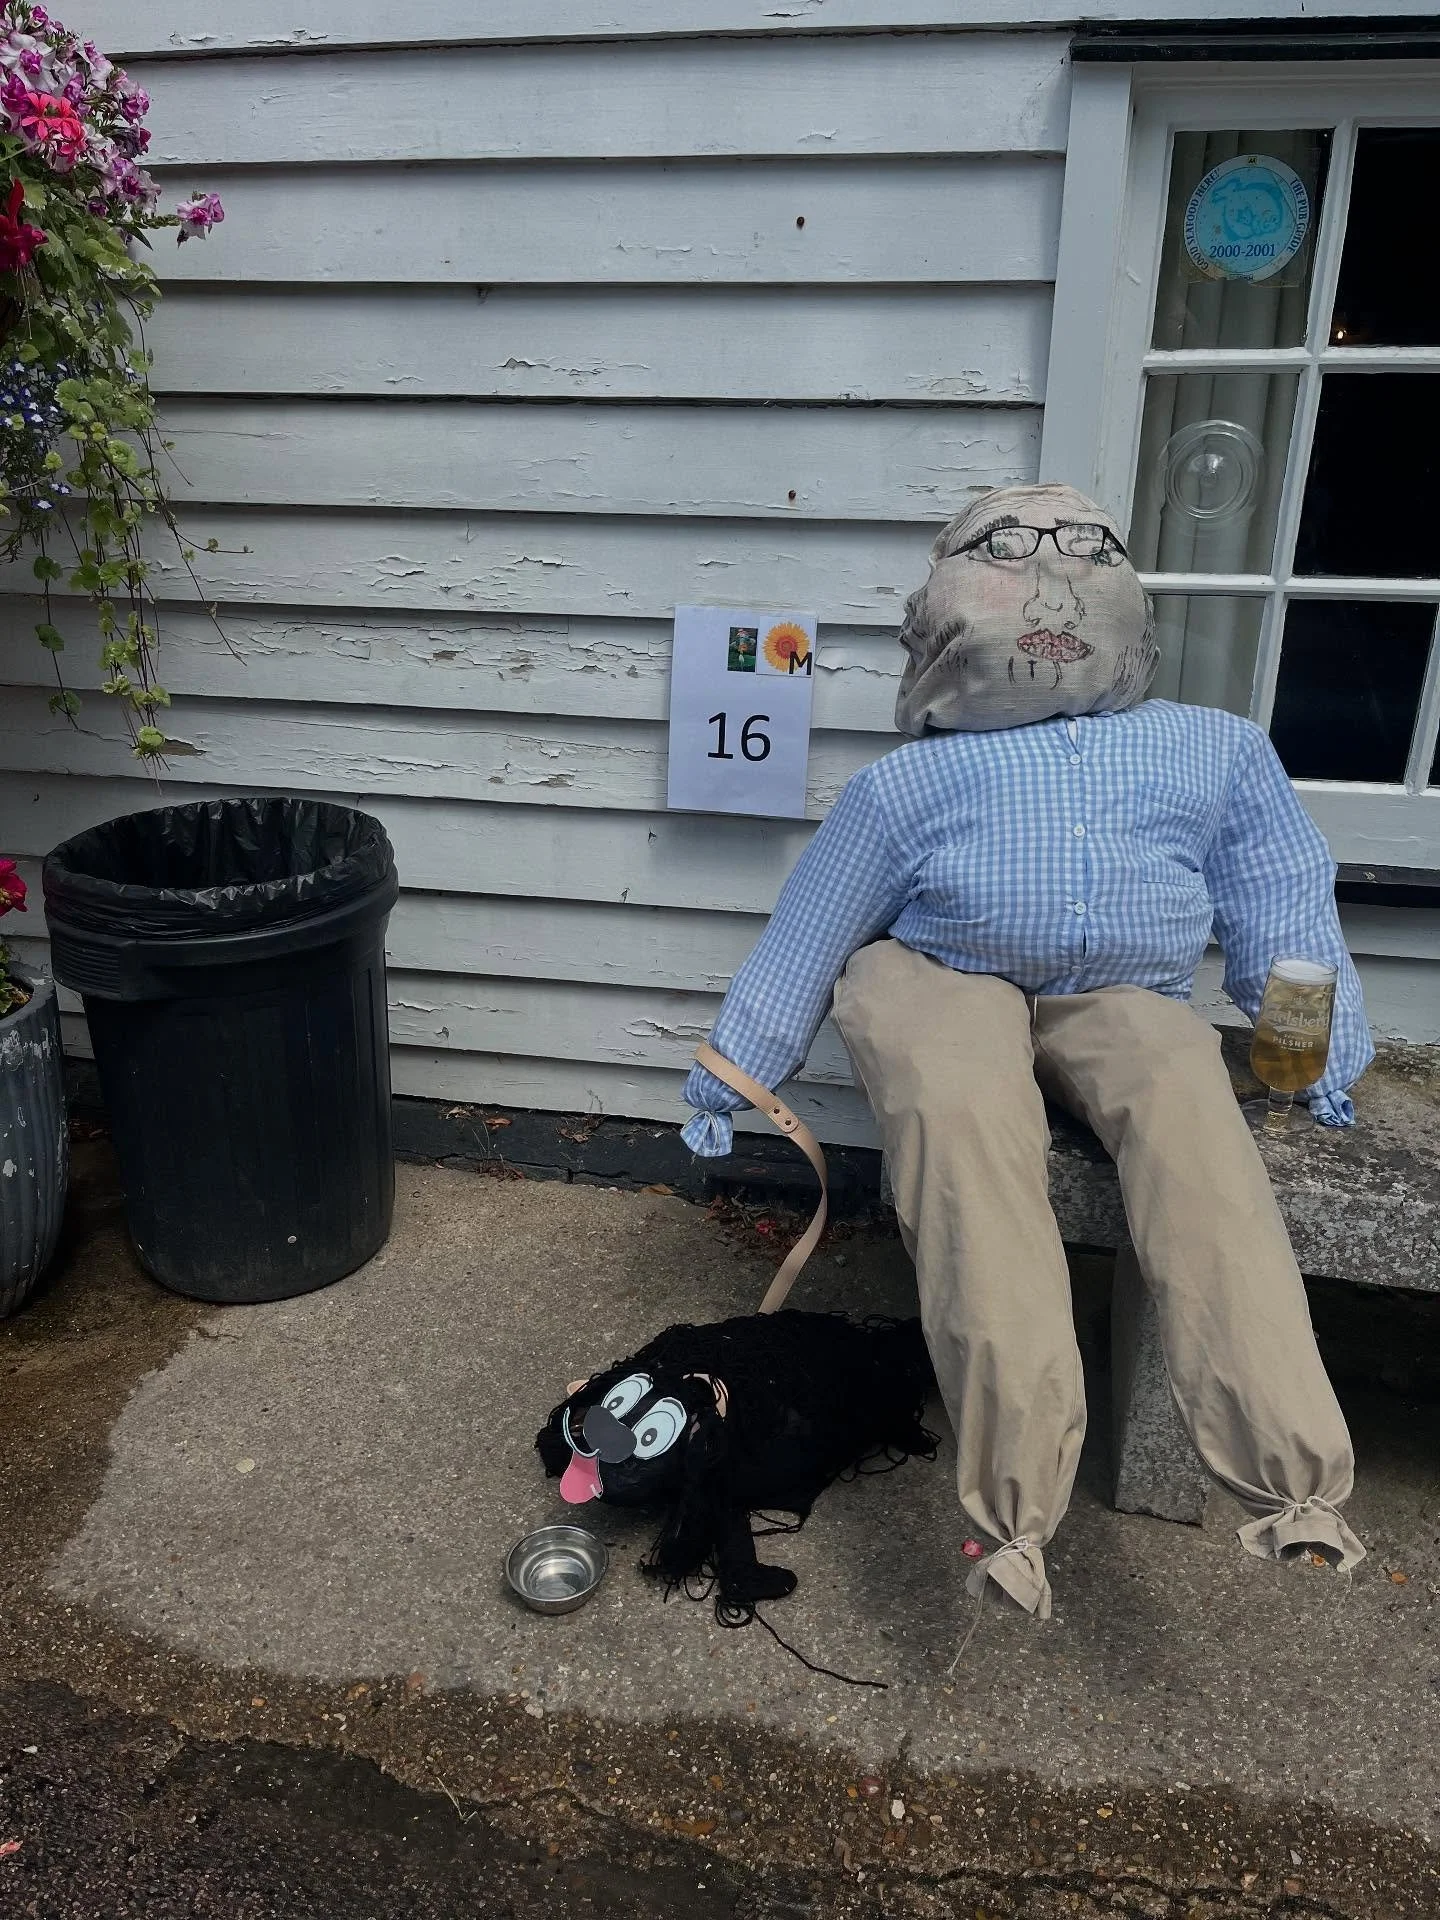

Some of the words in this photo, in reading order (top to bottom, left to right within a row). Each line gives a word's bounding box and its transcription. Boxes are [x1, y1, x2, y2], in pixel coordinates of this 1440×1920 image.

[1195, 168, 1221, 197] HERE!
[1290, 177, 1305, 198] THE
[1298, 199, 1309, 220] PUB
[1186, 200, 1199, 246] SEAFOOD
[1209, 243, 1276, 258] 2000-2001
[1286, 222, 1306, 254] GUIDE
[1189, 246, 1209, 270] GOOD
[788, 650, 813, 676] M
[707, 711, 771, 762] 16
[1273, 1035, 1314, 1048] PILSNER
